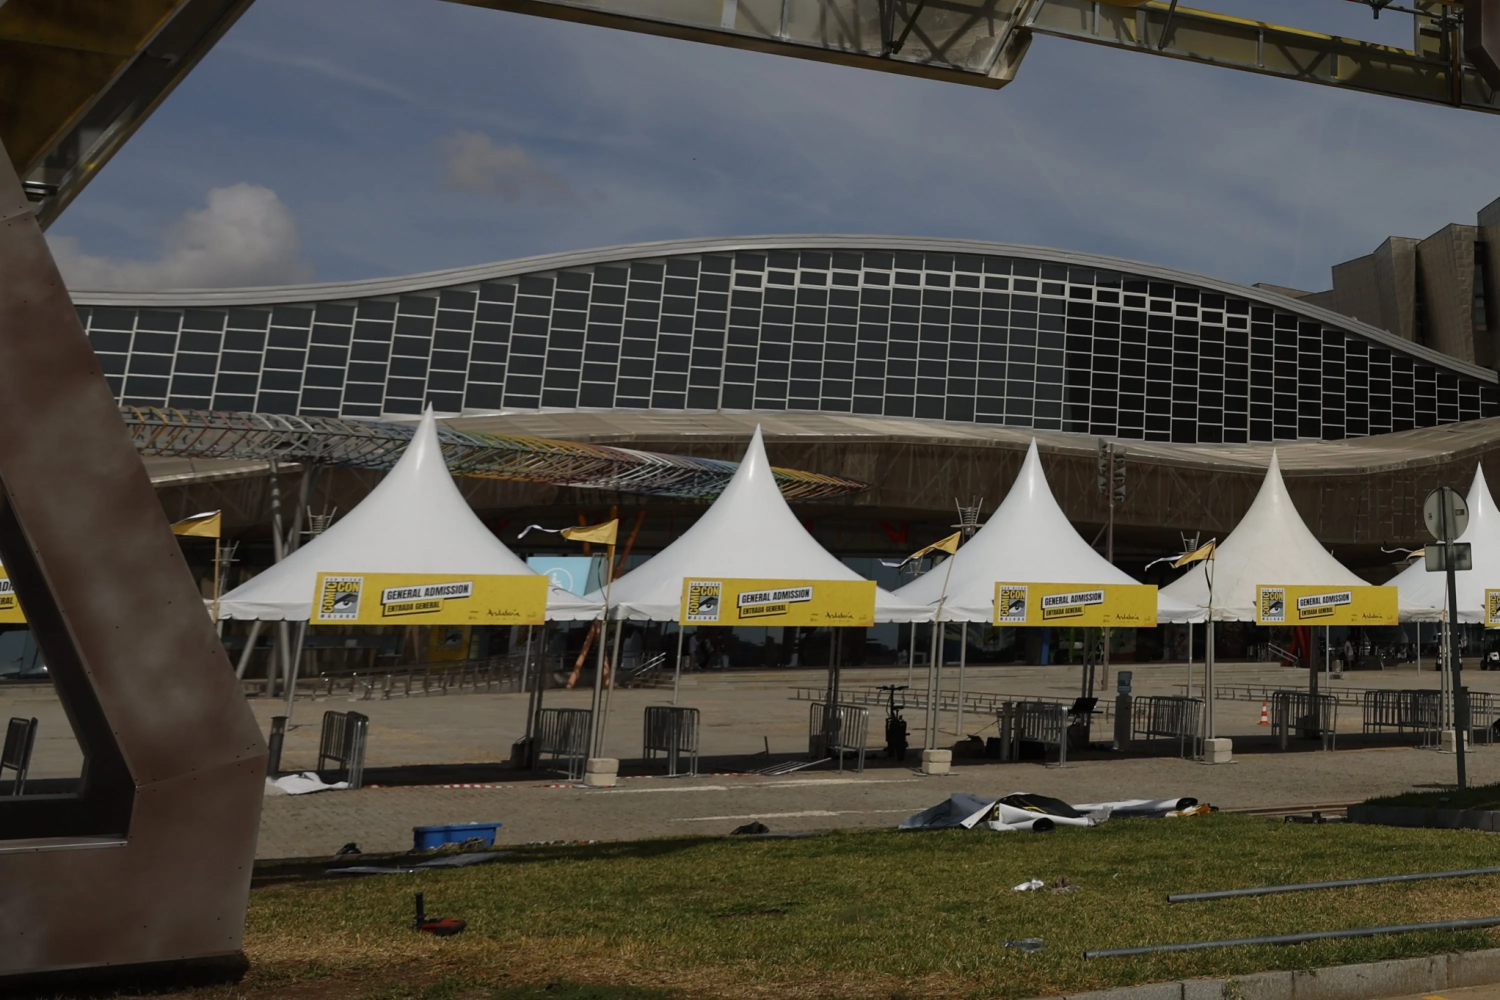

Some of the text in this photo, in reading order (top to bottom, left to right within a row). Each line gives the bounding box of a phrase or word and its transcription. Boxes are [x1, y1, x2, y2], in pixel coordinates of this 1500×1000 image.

[337, 582, 359, 592] CON
[387, 584, 469, 601] GENERAL ADMISSION
[700, 586, 719, 596] CON
[323, 581, 337, 613] COMIC
[689, 586, 701, 615] COMIC
[742, 589, 810, 604] GENERAL ADMISSION
[1009, 590, 1025, 599] CON
[1045, 592, 1102, 606] GENERAL ADMISSION
[1300, 593, 1350, 606] GENERAL ADMISSION
[387, 600, 440, 612] ENTRADA GENERAL
[743, 604, 786, 614] ENTRADA GENERAL
[1001, 590, 1010, 616] COMIC
[1045, 606, 1083, 616] ENTRADA GENERAL
